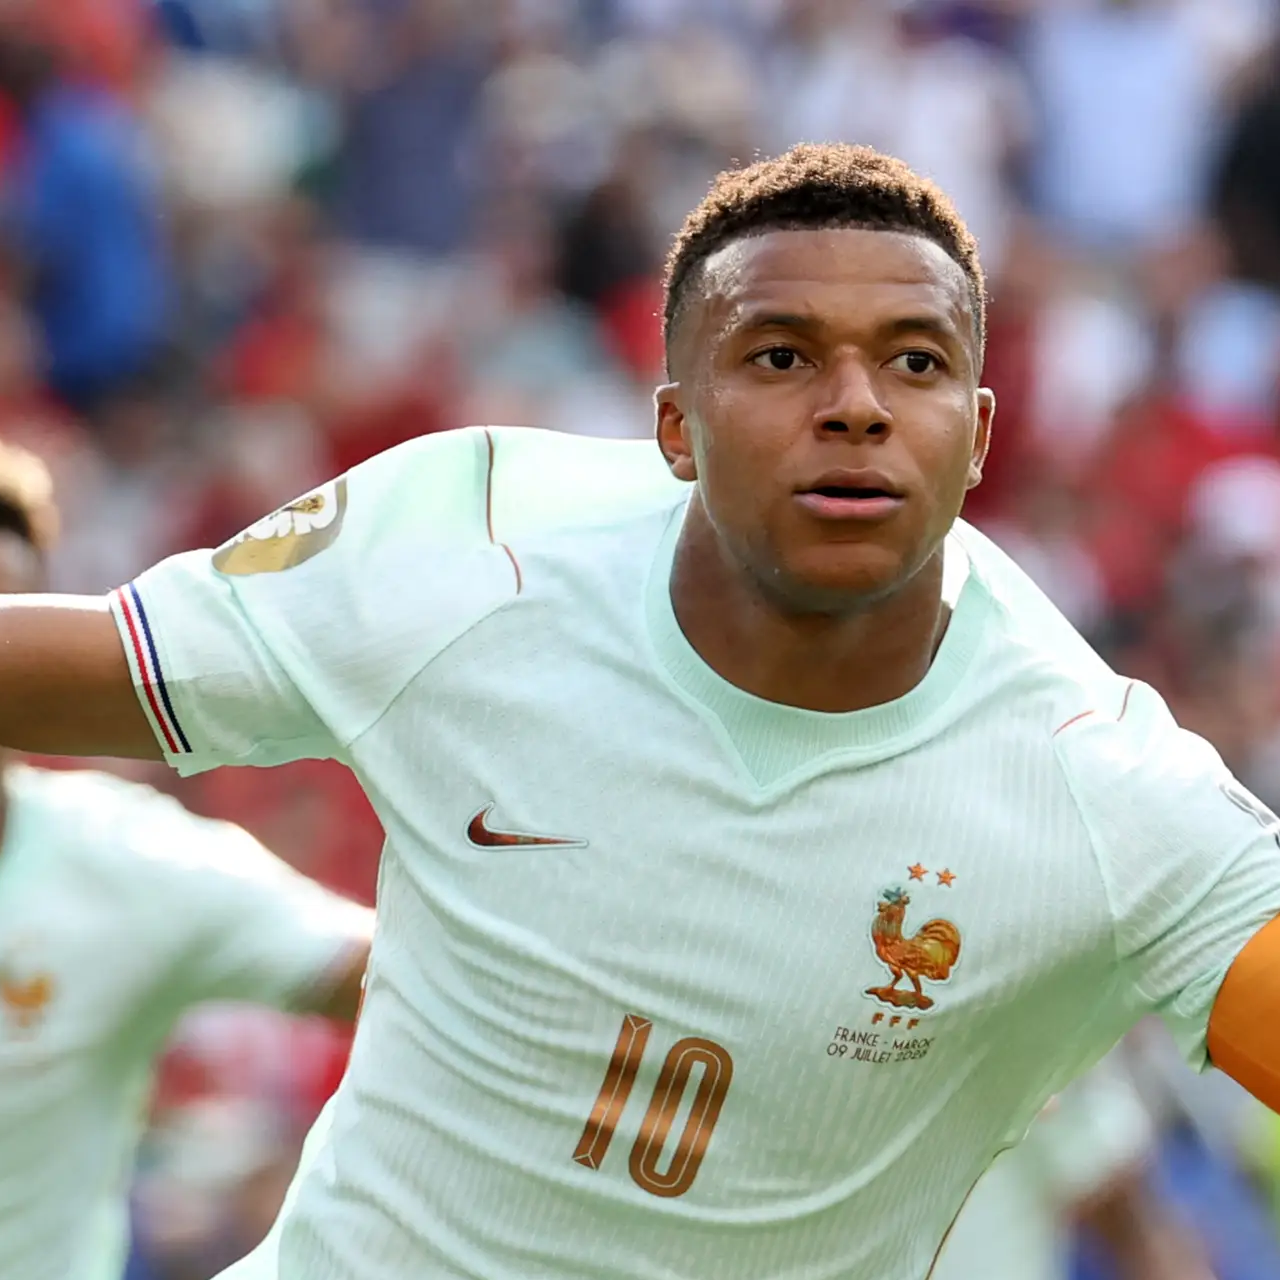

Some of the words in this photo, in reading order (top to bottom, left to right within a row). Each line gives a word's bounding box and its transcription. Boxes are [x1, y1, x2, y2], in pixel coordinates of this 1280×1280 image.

[833, 1026, 880, 1047] FRANCE
[827, 1043, 848, 1057] 09
[850, 1047, 893, 1063] JUILLET
[571, 1013, 734, 1199] 10
